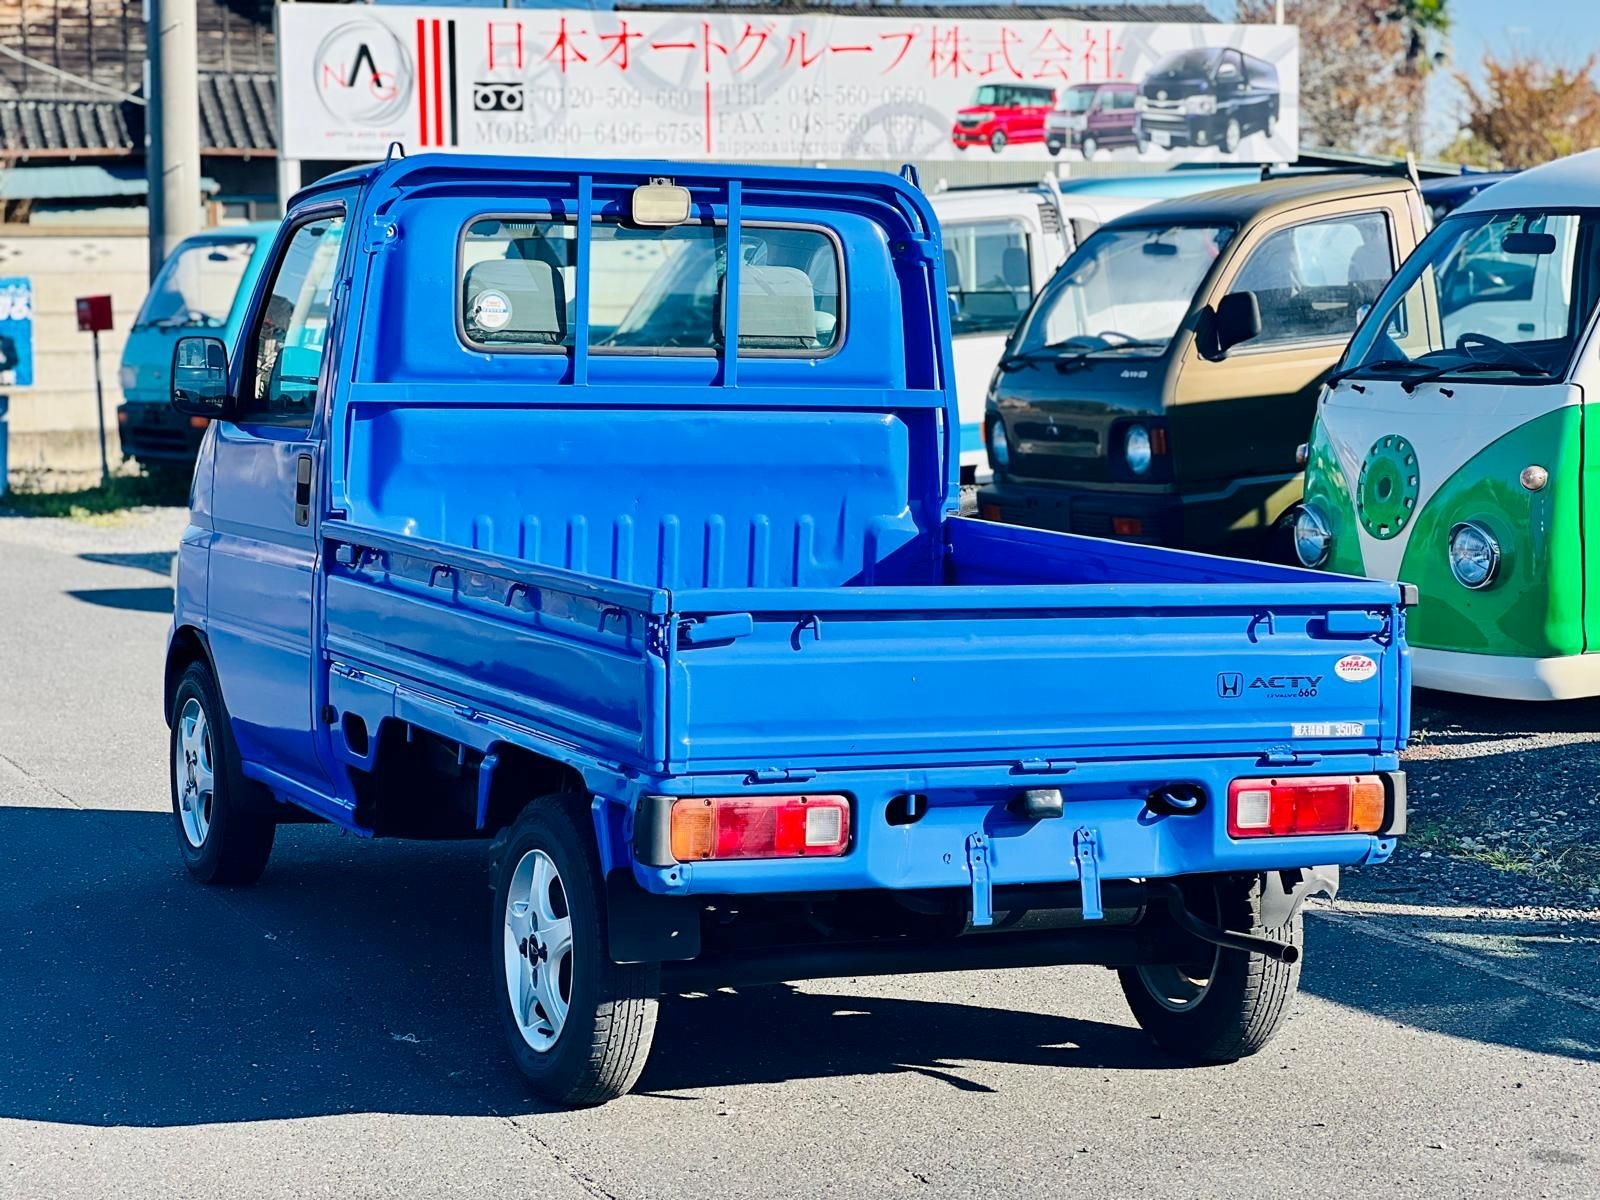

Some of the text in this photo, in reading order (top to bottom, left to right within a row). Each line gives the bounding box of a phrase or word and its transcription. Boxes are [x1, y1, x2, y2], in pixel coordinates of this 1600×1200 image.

[486, 16, 1127, 82] 日本オートグループ株式会社
[543, 86, 692, 110] 0120-509-660
[720, 83, 766, 105] TEL
[542, 121, 704, 145] 090-6496-6758
[717, 111, 765, 134] FAX
[1339, 660, 1373, 668] SHAZA
[1248, 676, 1323, 688] ACTY
[1298, 688, 1318, 697] 660
